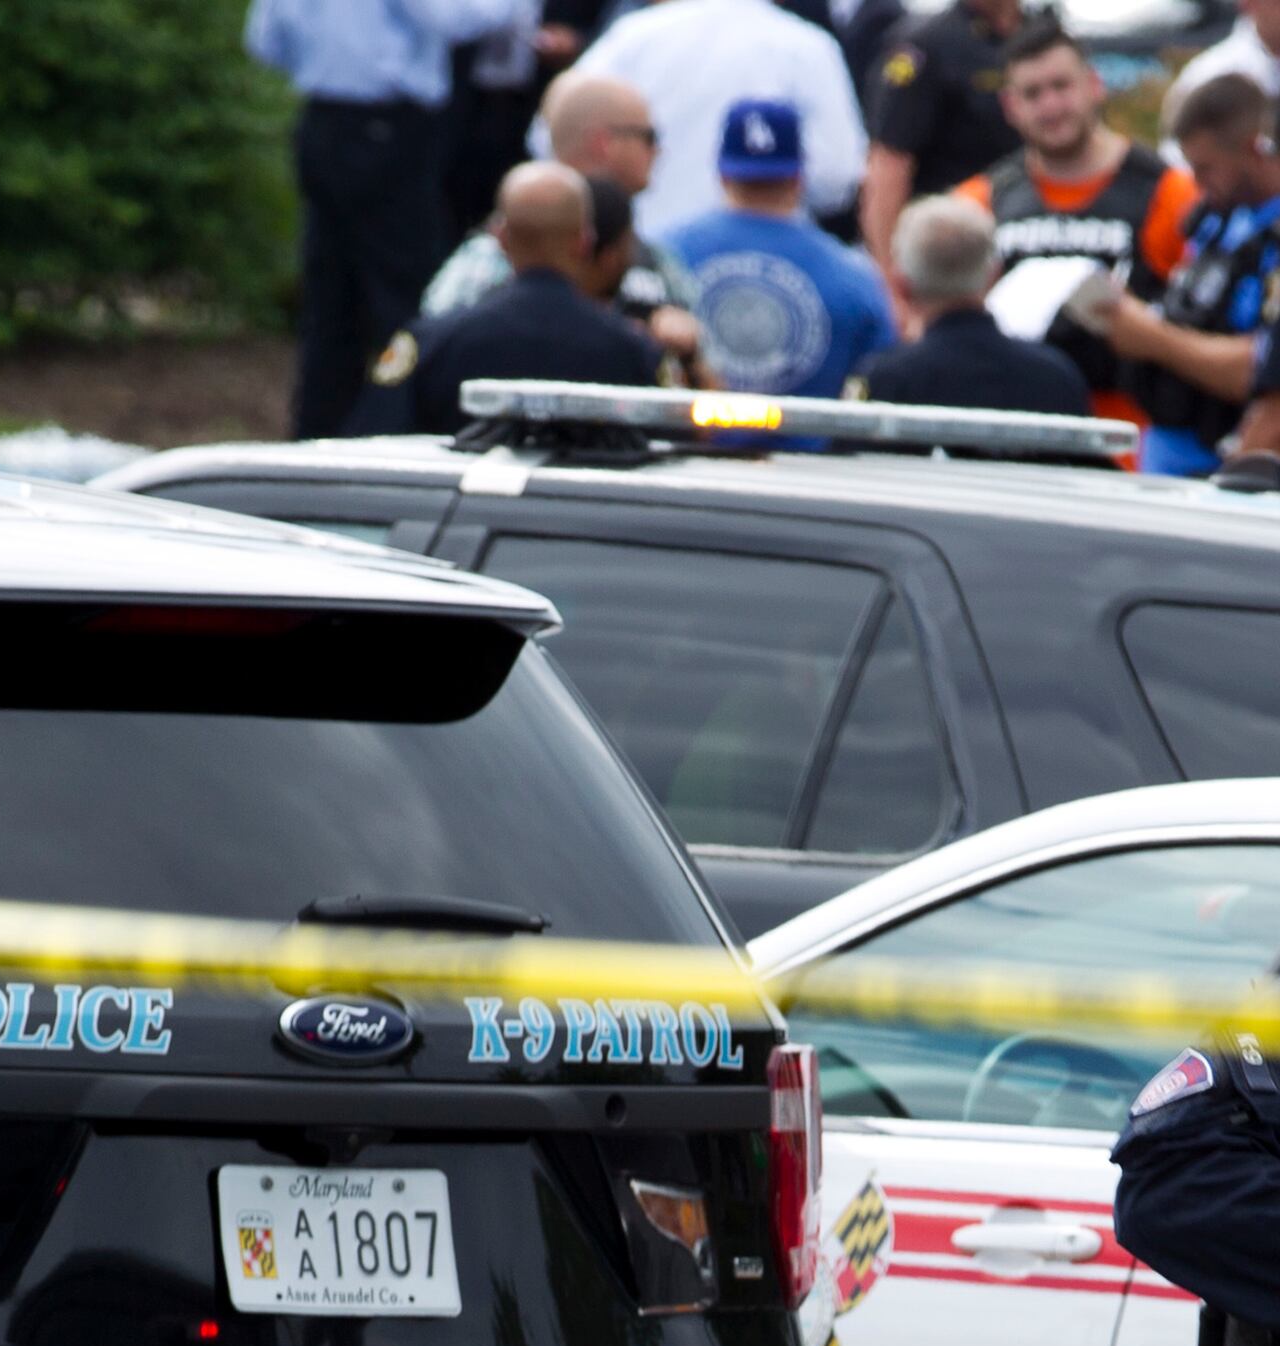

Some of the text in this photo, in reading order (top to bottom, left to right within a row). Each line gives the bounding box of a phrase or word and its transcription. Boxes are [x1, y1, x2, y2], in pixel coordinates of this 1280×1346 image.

[316, 1001, 387, 1046] Ford
[464, 996, 744, 1070] K-9 PATROL
[289, 1174, 374, 1206] Maryland
[328, 1209, 438, 1280] 1807
[285, 1285, 318, 1303] Anne
[322, 1288, 375, 1304] Arundel
